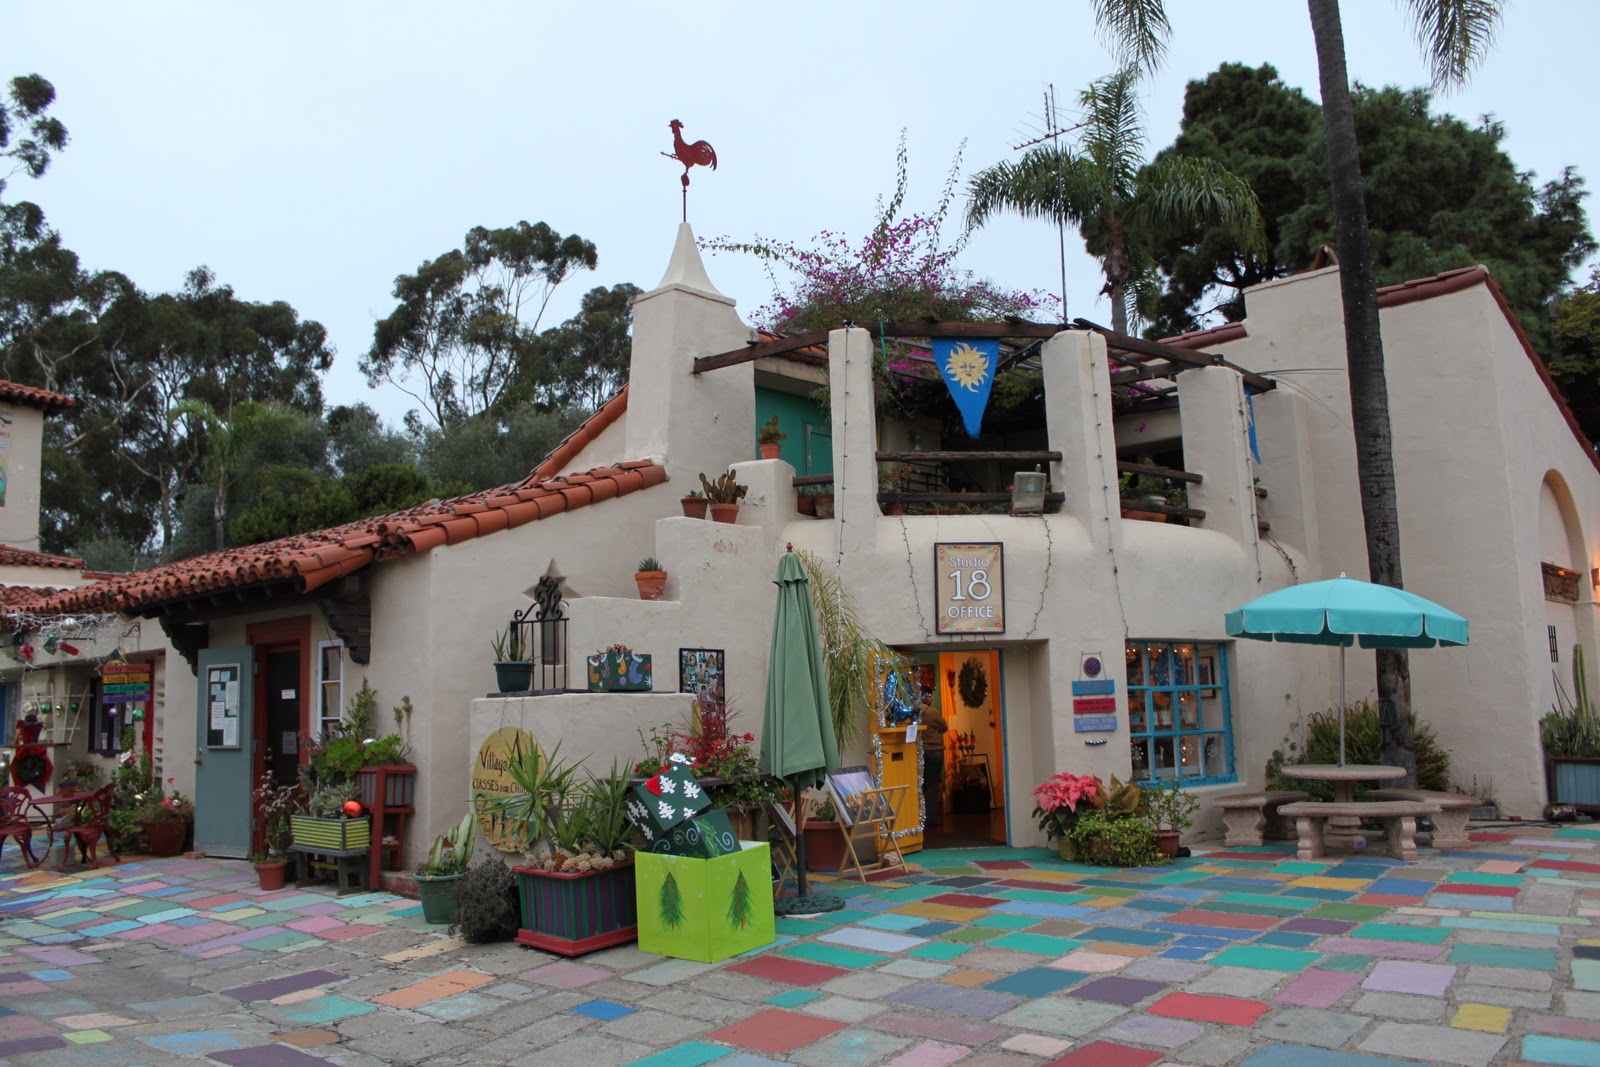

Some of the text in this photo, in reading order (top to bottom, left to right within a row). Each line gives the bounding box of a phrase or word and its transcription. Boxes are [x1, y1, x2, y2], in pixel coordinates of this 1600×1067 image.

[949, 556, 990, 568] Studio
[949, 569, 992, 601] 18
[948, 605, 994, 618] OFFICE
[480, 745, 508, 777] Village
